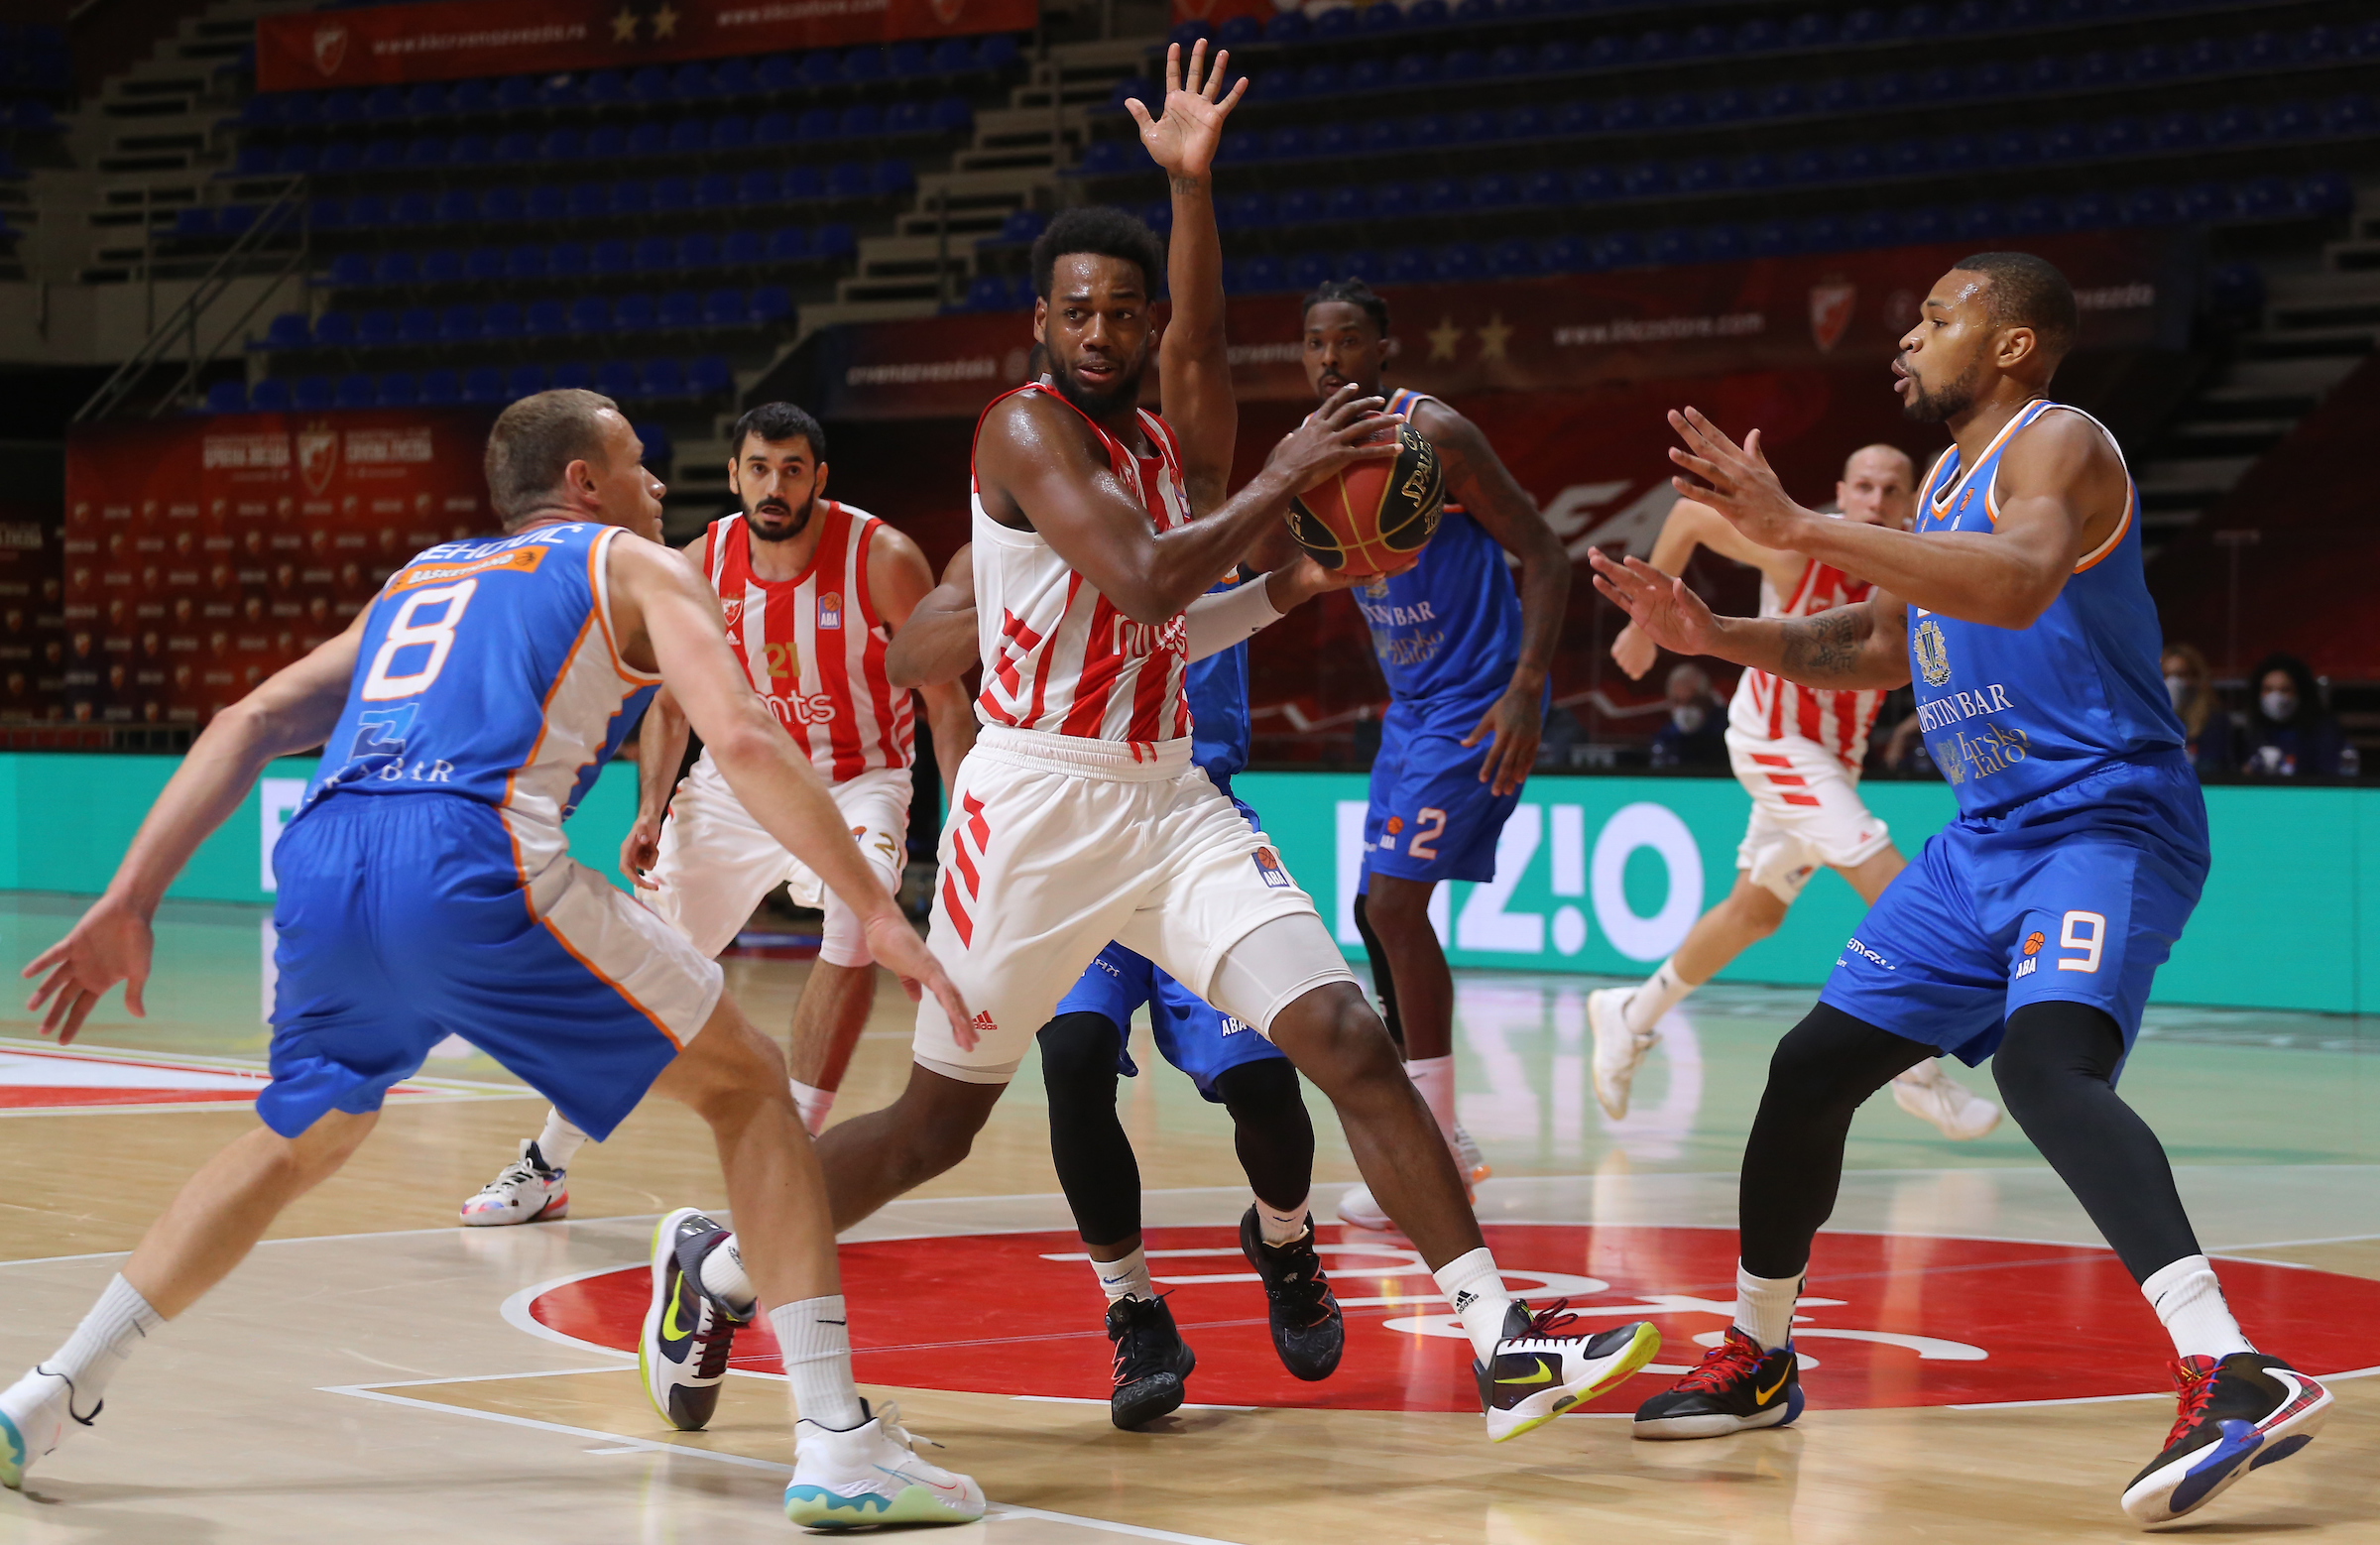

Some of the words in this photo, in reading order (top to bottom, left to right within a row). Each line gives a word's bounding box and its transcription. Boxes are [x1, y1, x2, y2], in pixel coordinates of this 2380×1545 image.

[821, 612, 838, 626] ABA
[1393, 601, 1436, 626] BAR
[361, 578, 478, 702] 8
[763, 642, 801, 678] 21
[1956, 684, 2014, 718] BAR
[1408, 807, 1447, 860] 2
[1263, 871, 1287, 886] ABA
[2058, 909, 2106, 974] 9
[2015, 956, 2037, 980] ABA
